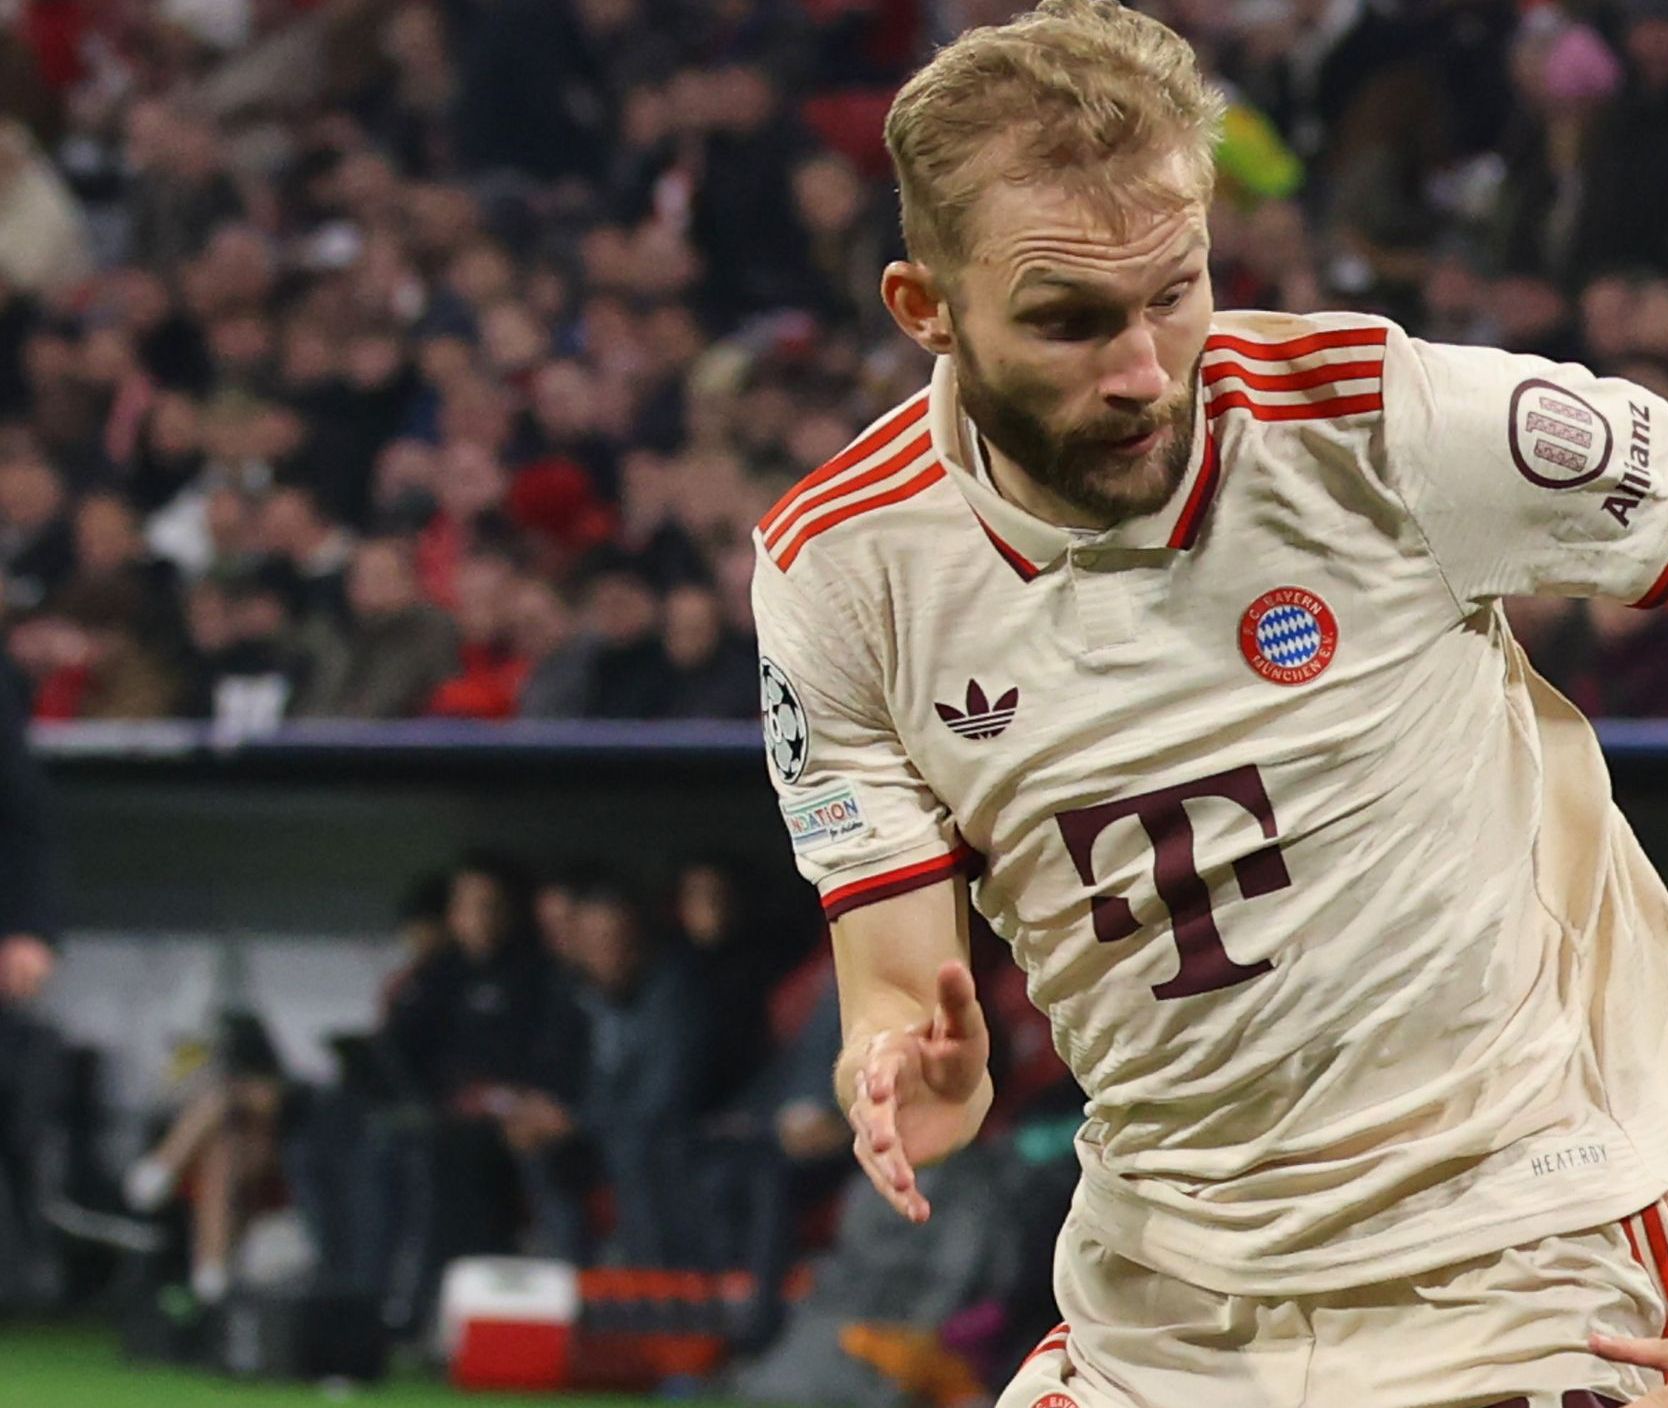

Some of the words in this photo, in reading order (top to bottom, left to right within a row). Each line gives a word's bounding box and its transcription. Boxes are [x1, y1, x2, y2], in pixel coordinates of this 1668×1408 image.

[1601, 400, 1651, 528] Allianz
[1263, 591, 1323, 615] BAYERN
[1055, 763, 1292, 1001] T
[1531, 1144, 1608, 1177] HEAT.RDY
